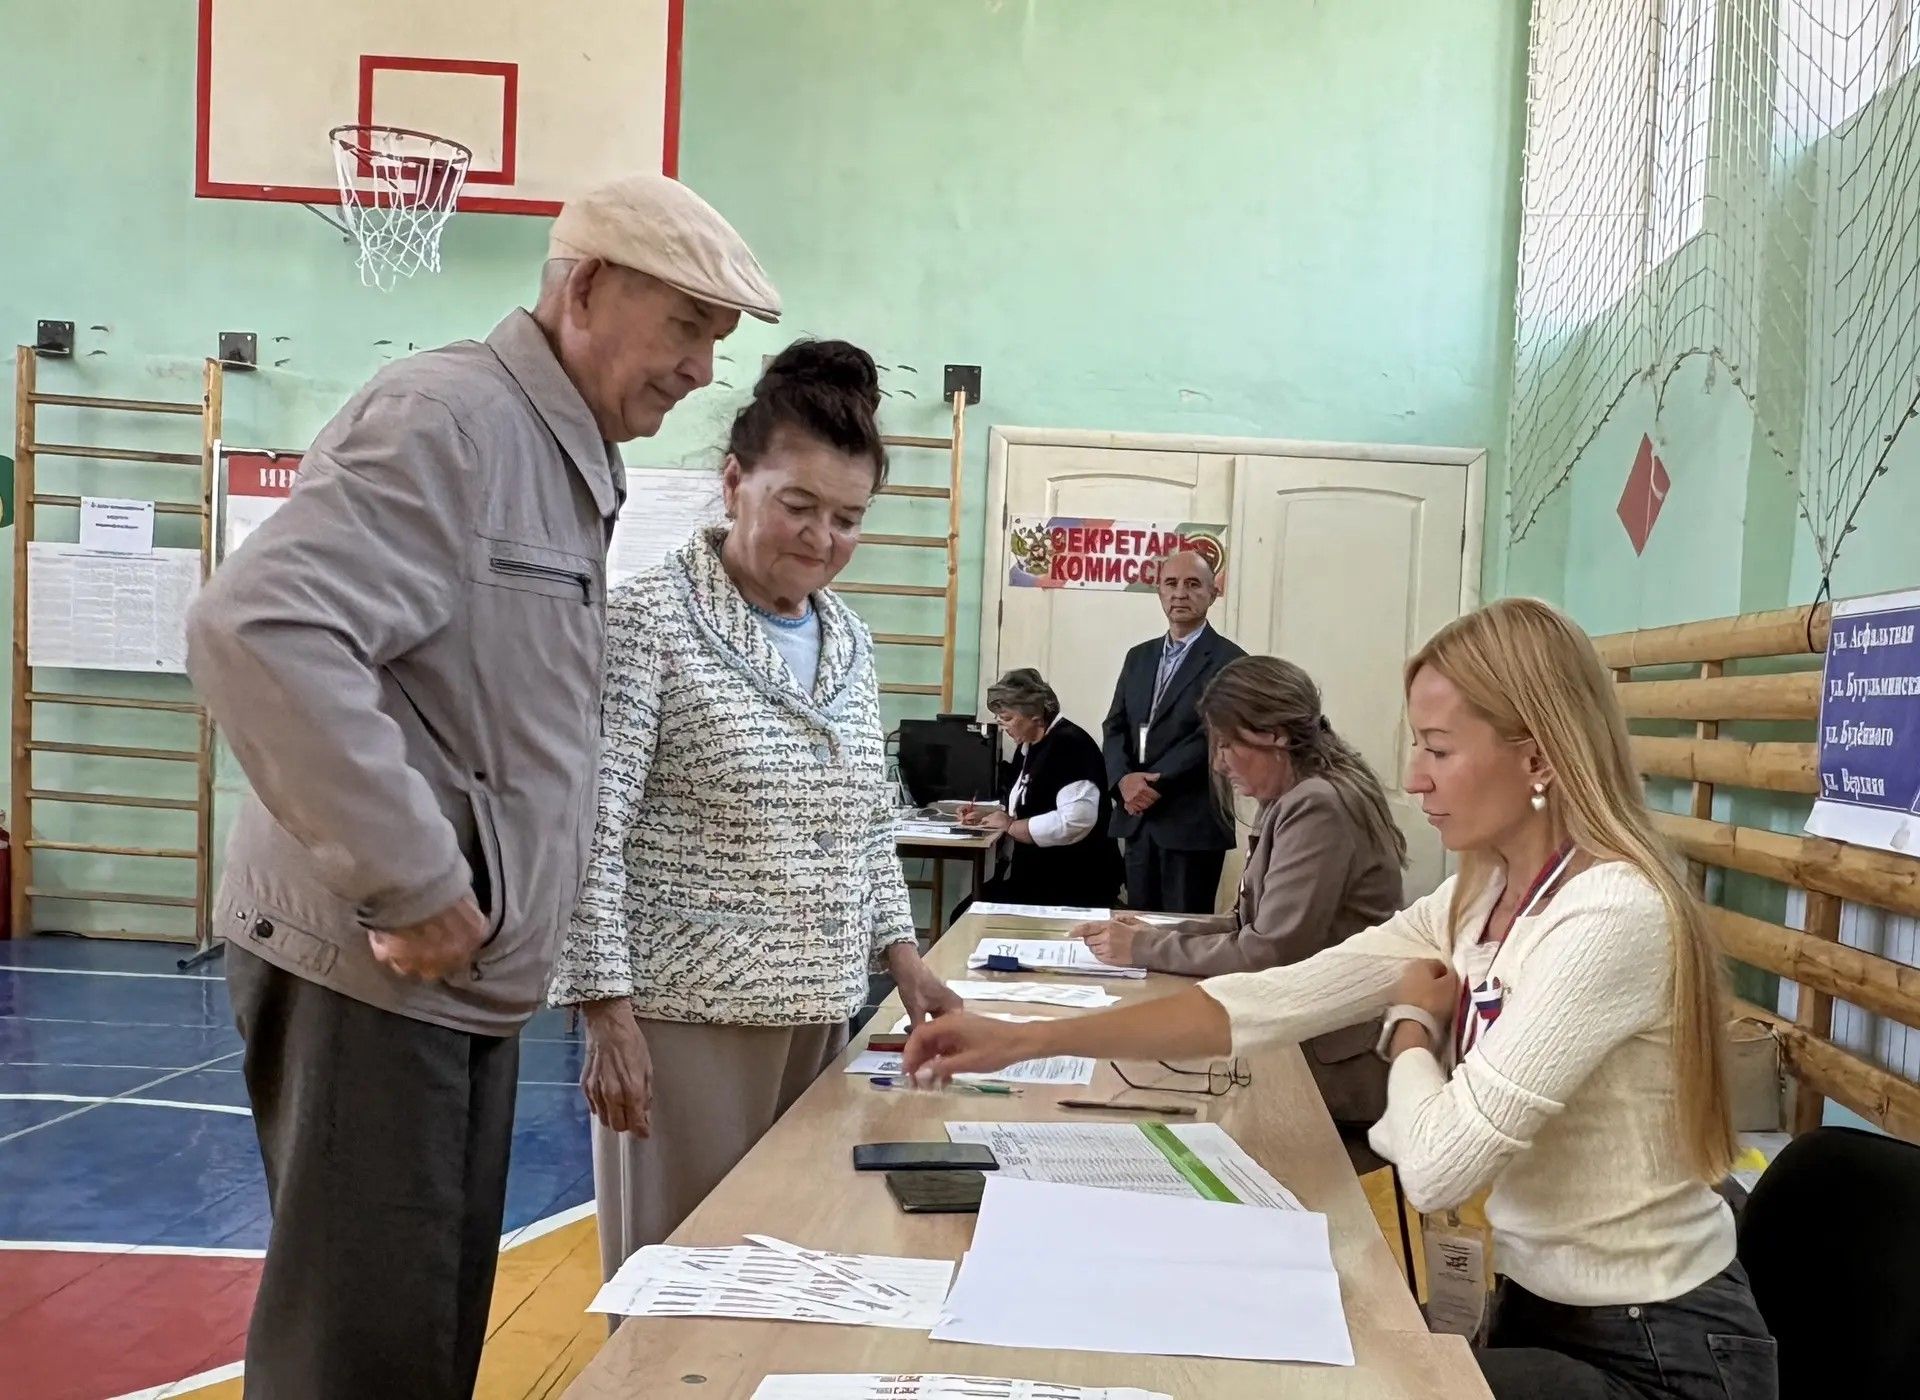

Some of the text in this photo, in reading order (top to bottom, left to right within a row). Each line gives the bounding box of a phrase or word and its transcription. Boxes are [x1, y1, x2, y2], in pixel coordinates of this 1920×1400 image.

[1051, 527, 1195, 557] СЕКРЕТАРЬ
[1832, 622, 1915, 656] ул. Асфальтная
[1828, 679, 1844, 703] ул.
[1824, 726, 1838, 749] ул.
